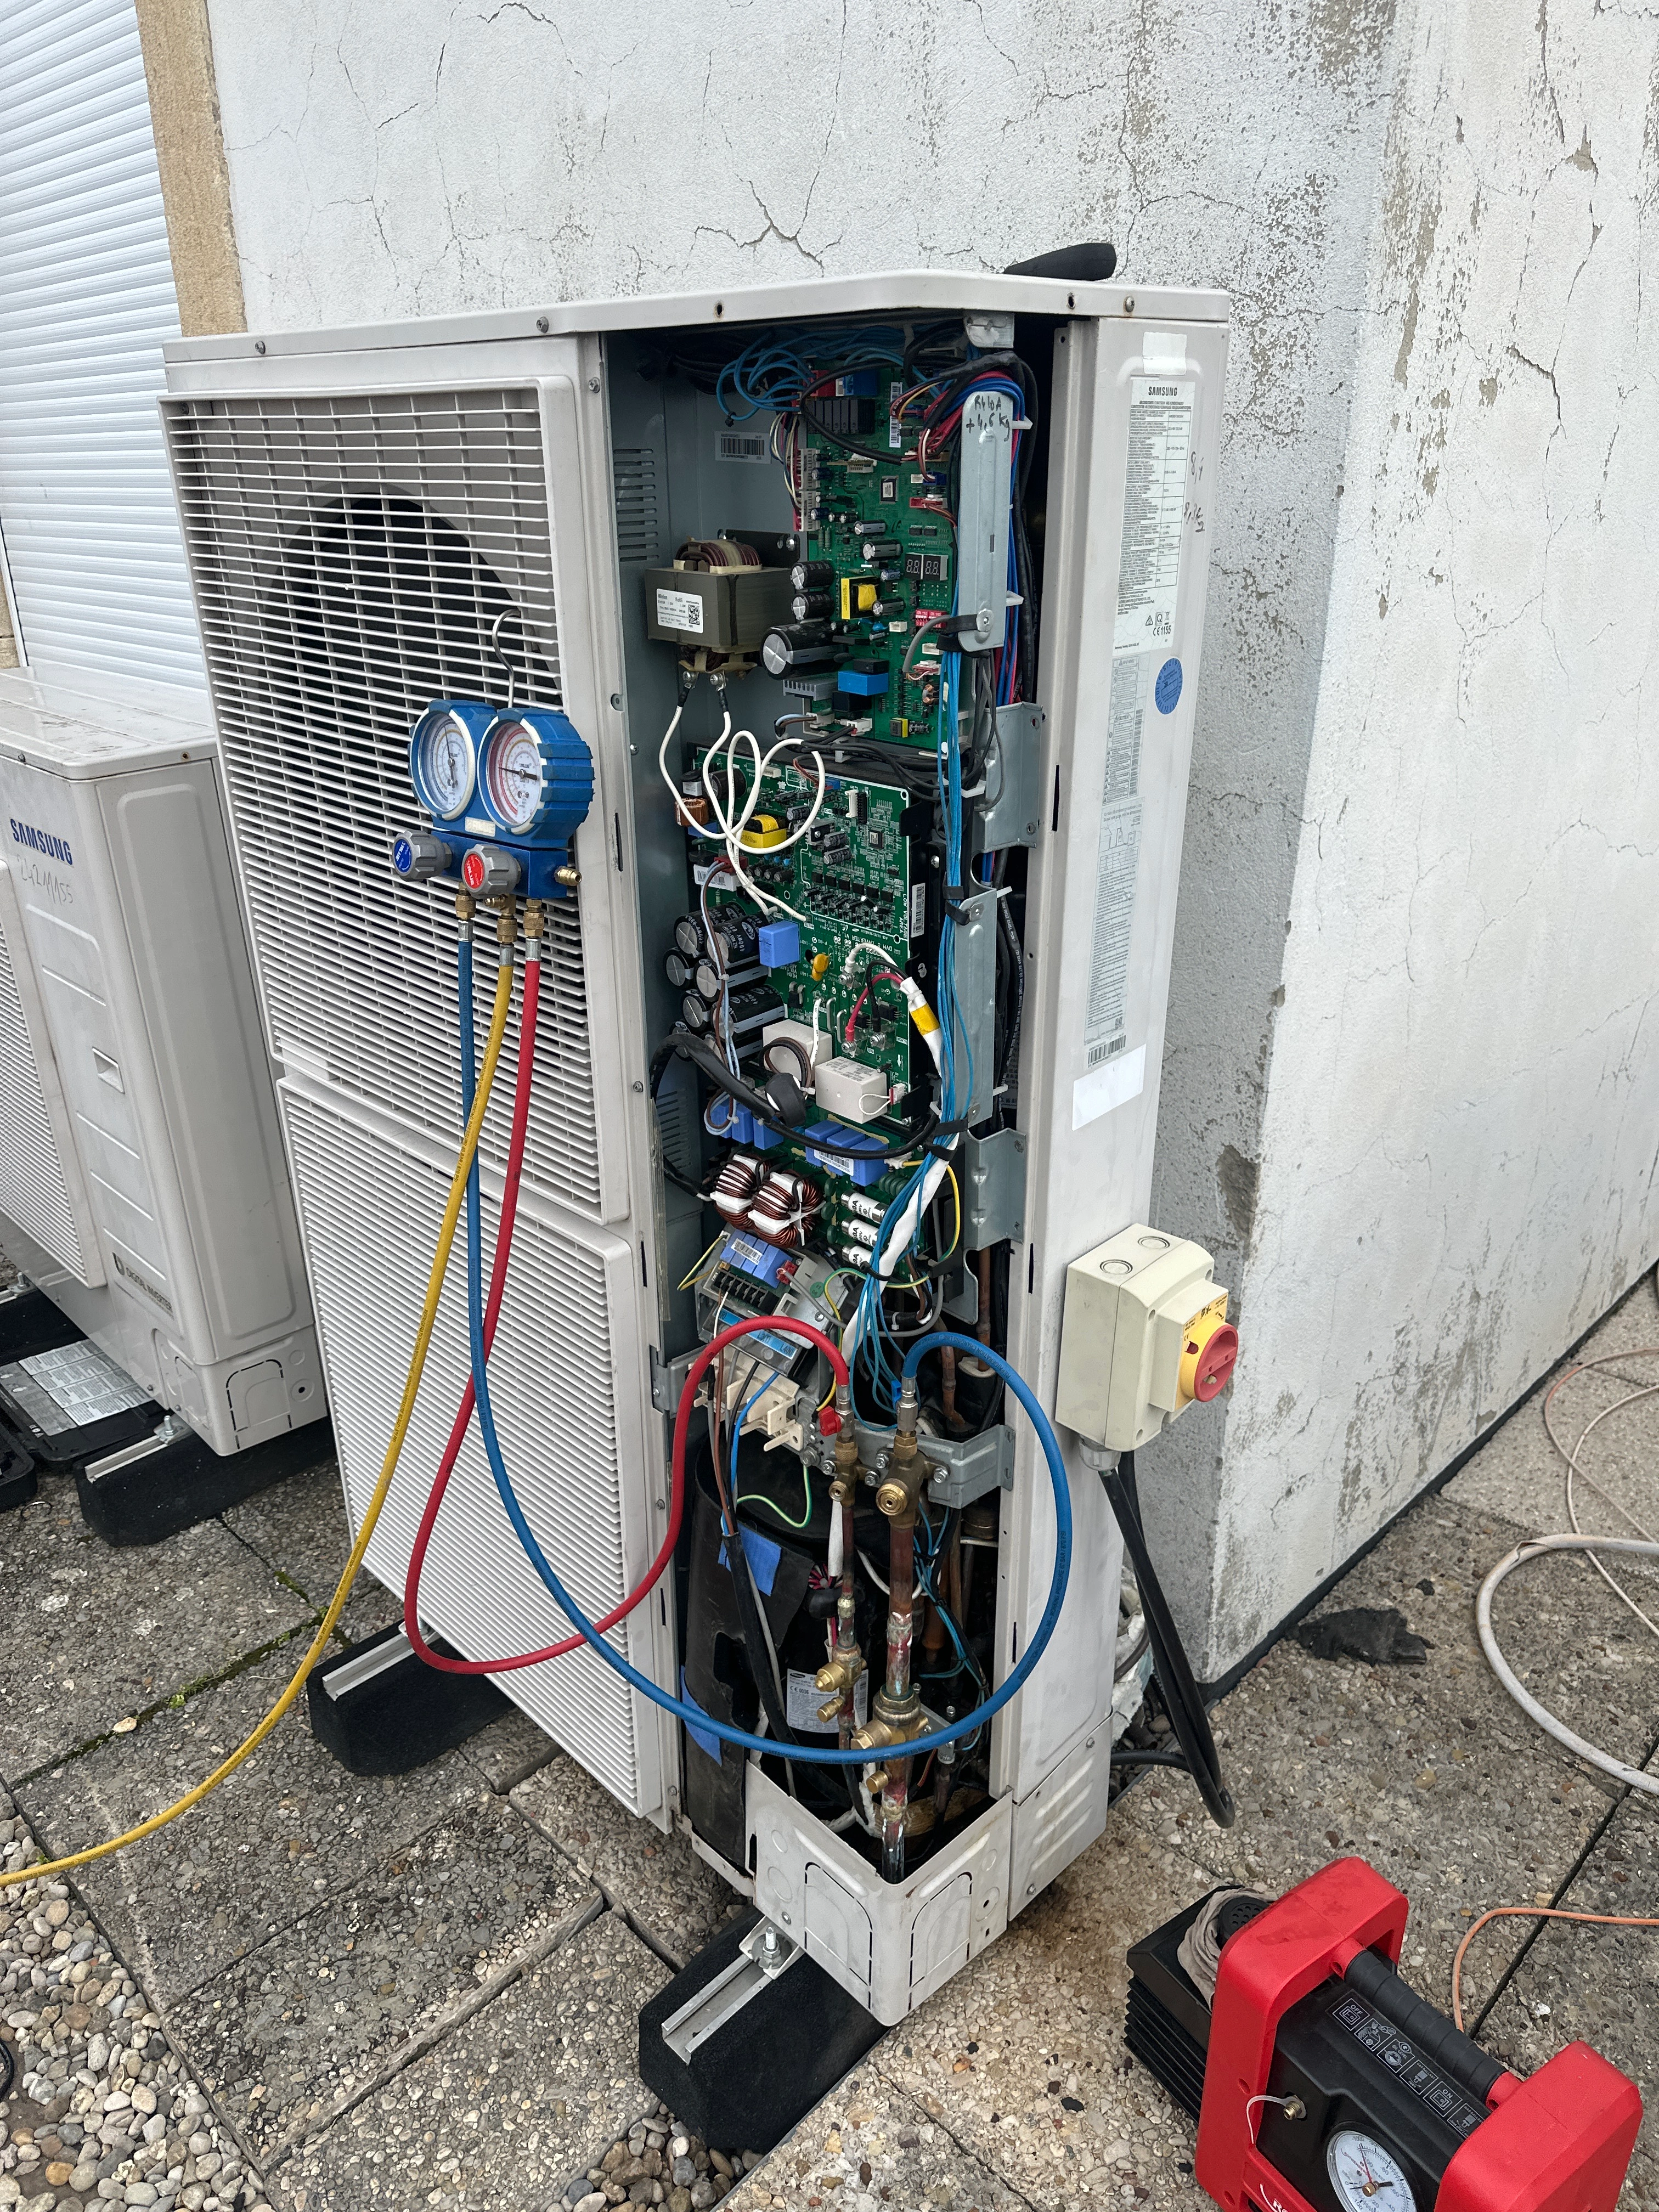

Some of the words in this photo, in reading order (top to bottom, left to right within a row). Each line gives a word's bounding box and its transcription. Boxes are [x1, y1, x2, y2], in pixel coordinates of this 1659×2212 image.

[1148, 386, 1178, 397] SAMSUNG
[974, 395, 1001, 411] R410A
[10, 819, 73, 865] SAMSUNG
[486, 1015, 496, 1054] REFRIGERATION
[470, 1097, 478, 1120] WORKING
[462, 1120, 473, 1147] PRESSURE
[1351, 2005, 1363, 2015] OFF
[1423, 2067, 1436, 2080] BALLAST
[1442, 2089, 1453, 2099] ON
